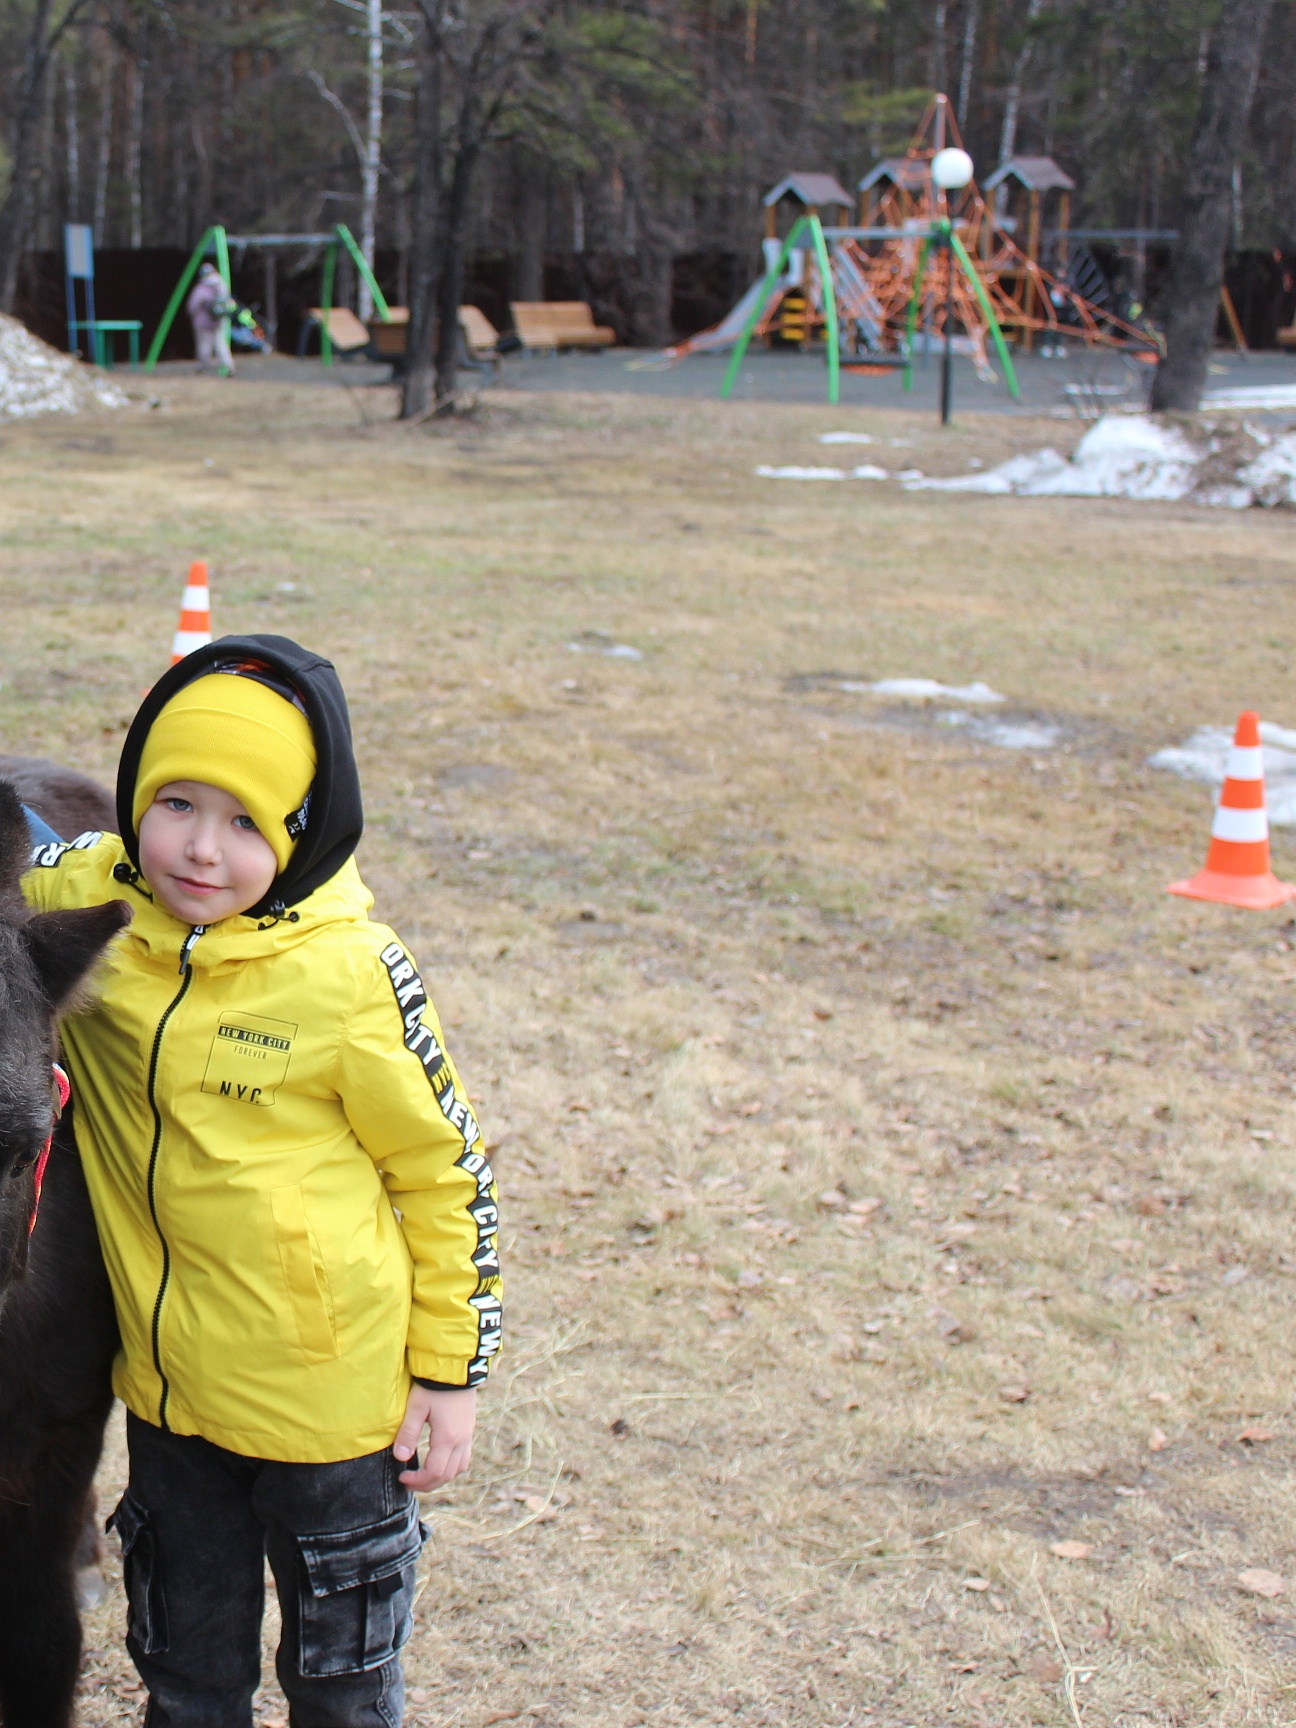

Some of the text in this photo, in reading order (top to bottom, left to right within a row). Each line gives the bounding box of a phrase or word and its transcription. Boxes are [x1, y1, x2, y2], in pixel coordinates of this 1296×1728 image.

[220, 1027, 288, 1050] NEW YORK CITY
[234, 1045, 268, 1060] FOREVER
[380, 942, 424, 1008] ORK
[469, 1294, 502, 1357] NEW
